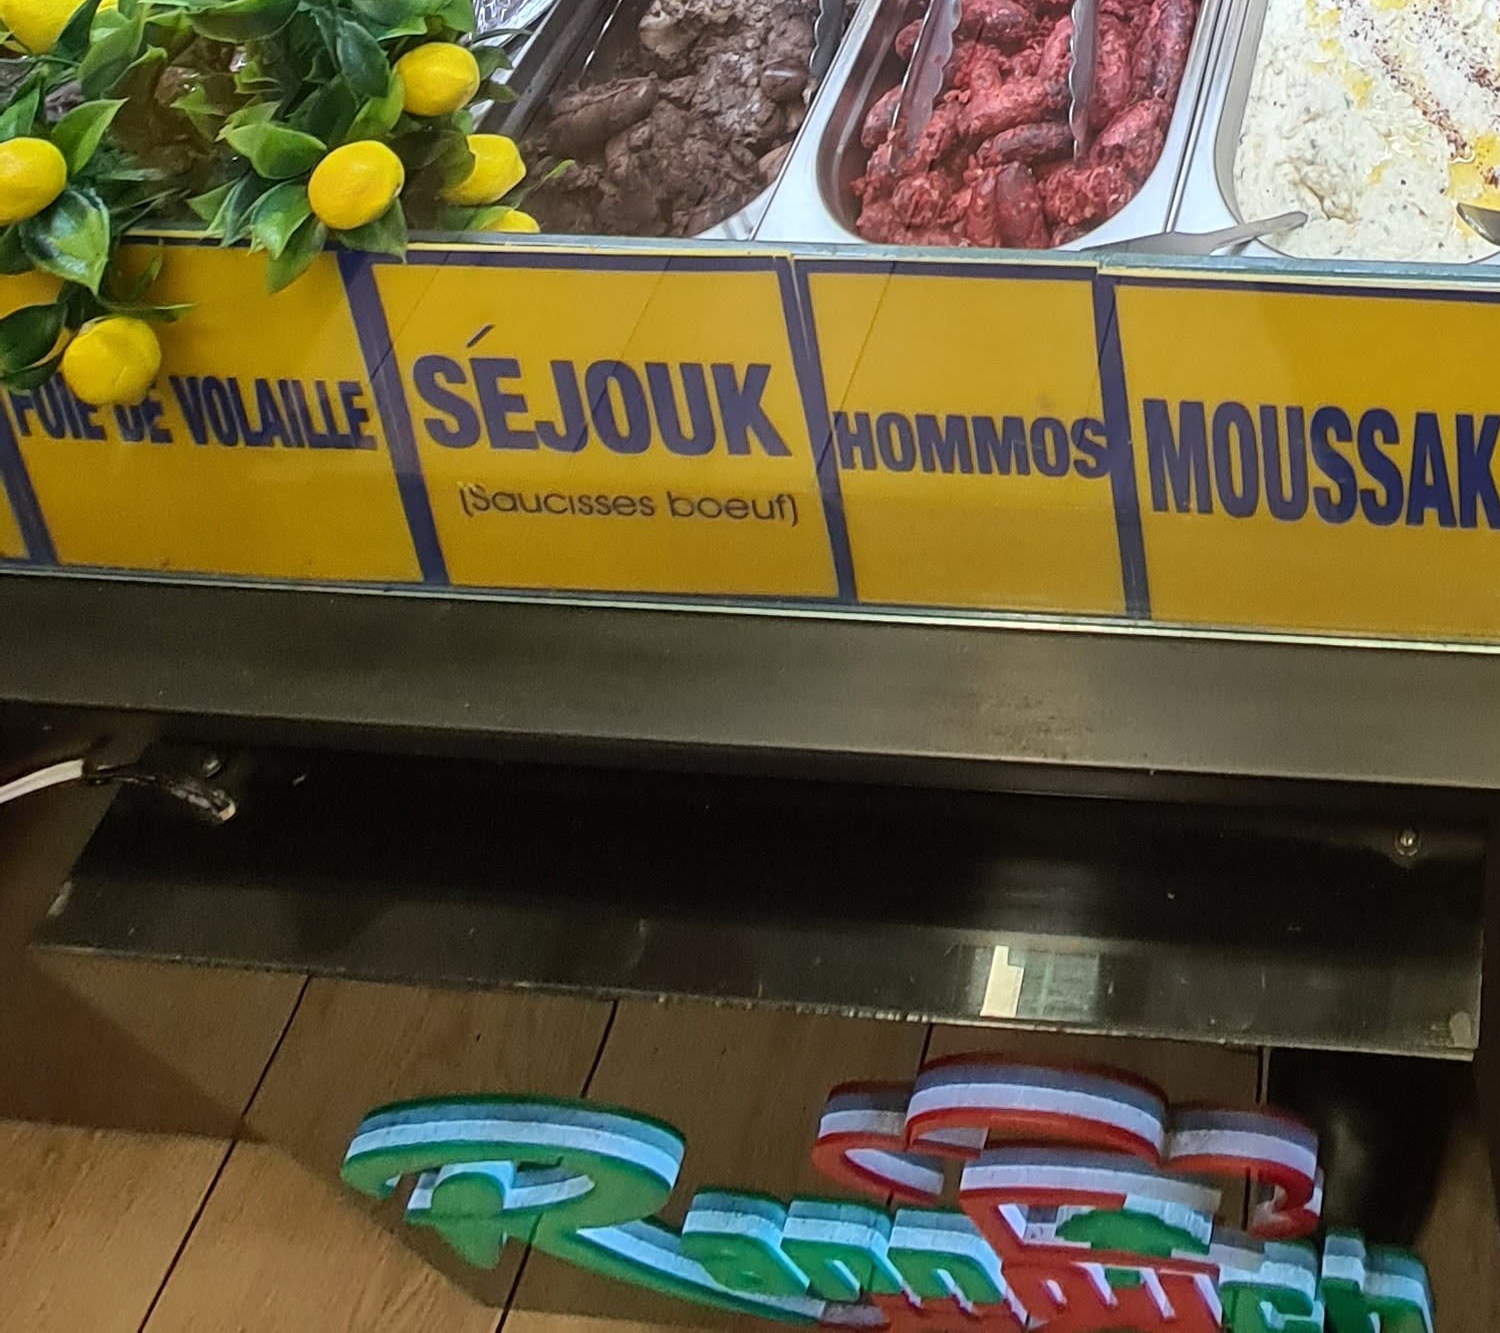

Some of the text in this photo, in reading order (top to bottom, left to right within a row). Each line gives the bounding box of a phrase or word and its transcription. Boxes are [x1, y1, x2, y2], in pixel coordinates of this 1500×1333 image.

[169, 375, 378, 451] VOLAILLE
[412, 324, 793, 458] SÉJOUK
[832, 410, 1114, 479] HOMMOS
[459, 481, 800, 526] (Saucisses boeuf)
